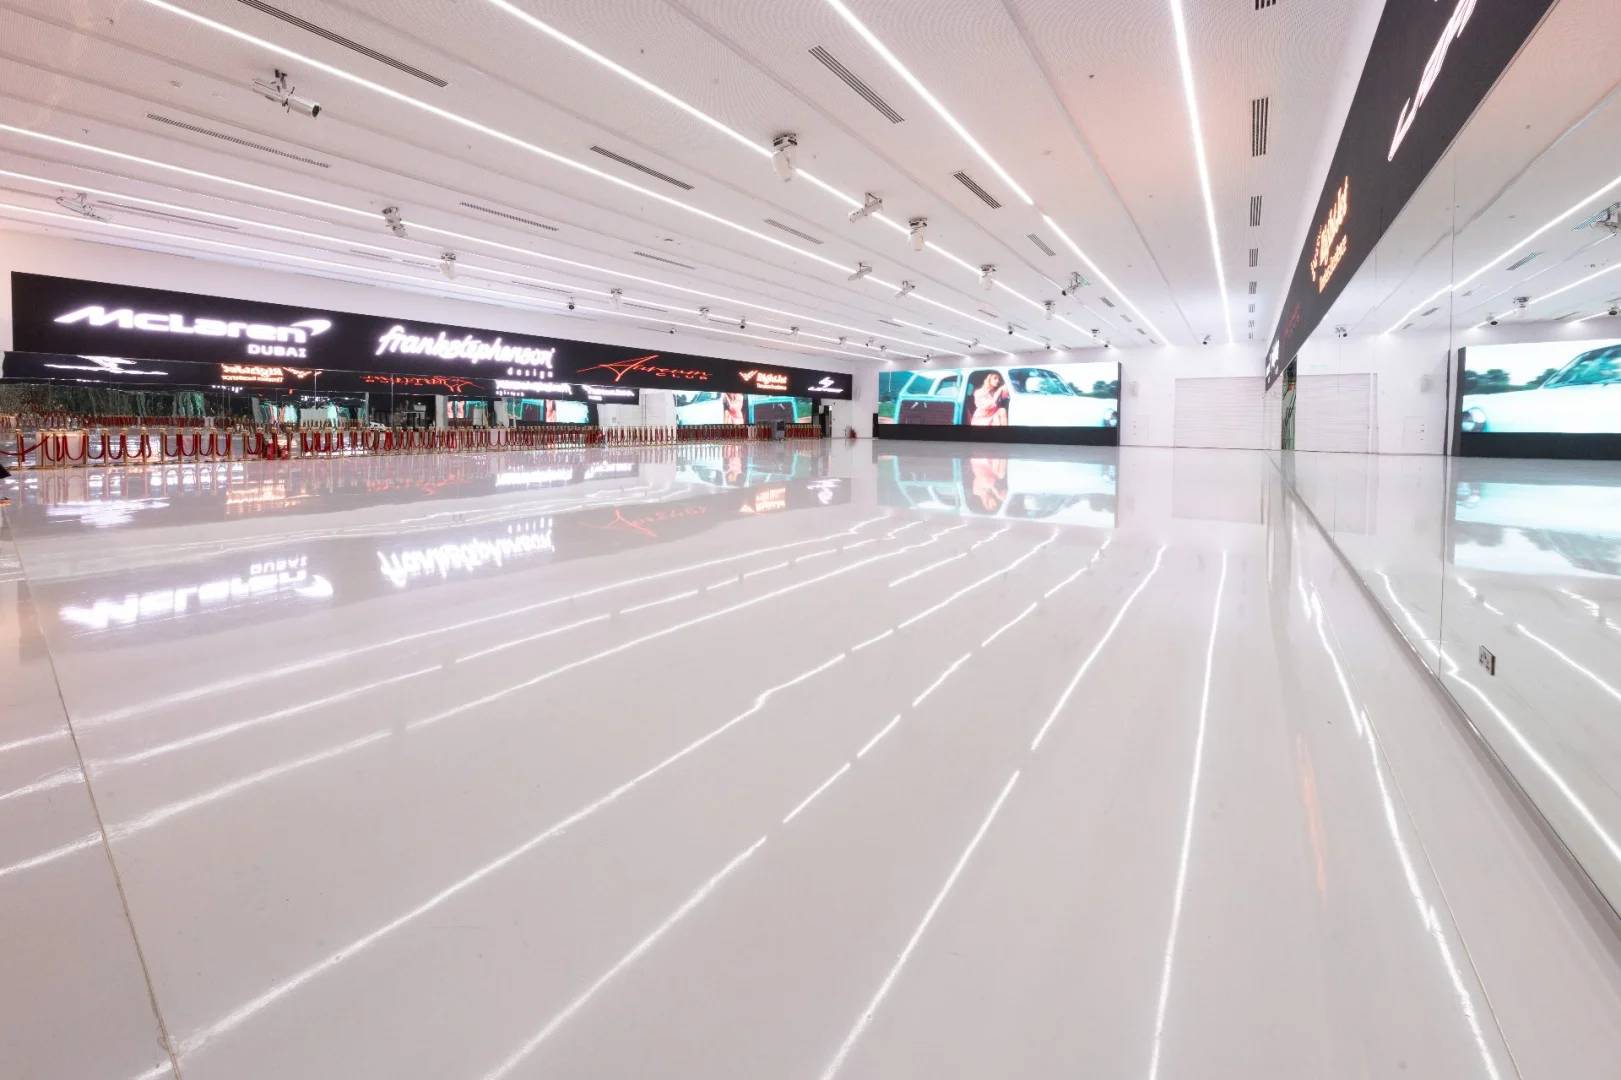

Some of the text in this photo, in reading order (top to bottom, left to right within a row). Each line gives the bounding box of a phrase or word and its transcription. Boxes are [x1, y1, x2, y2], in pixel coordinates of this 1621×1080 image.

[54, 304, 307, 343] McLaren
[247, 343, 308, 358] DUBAI
[507, 366, 553, 379] design
